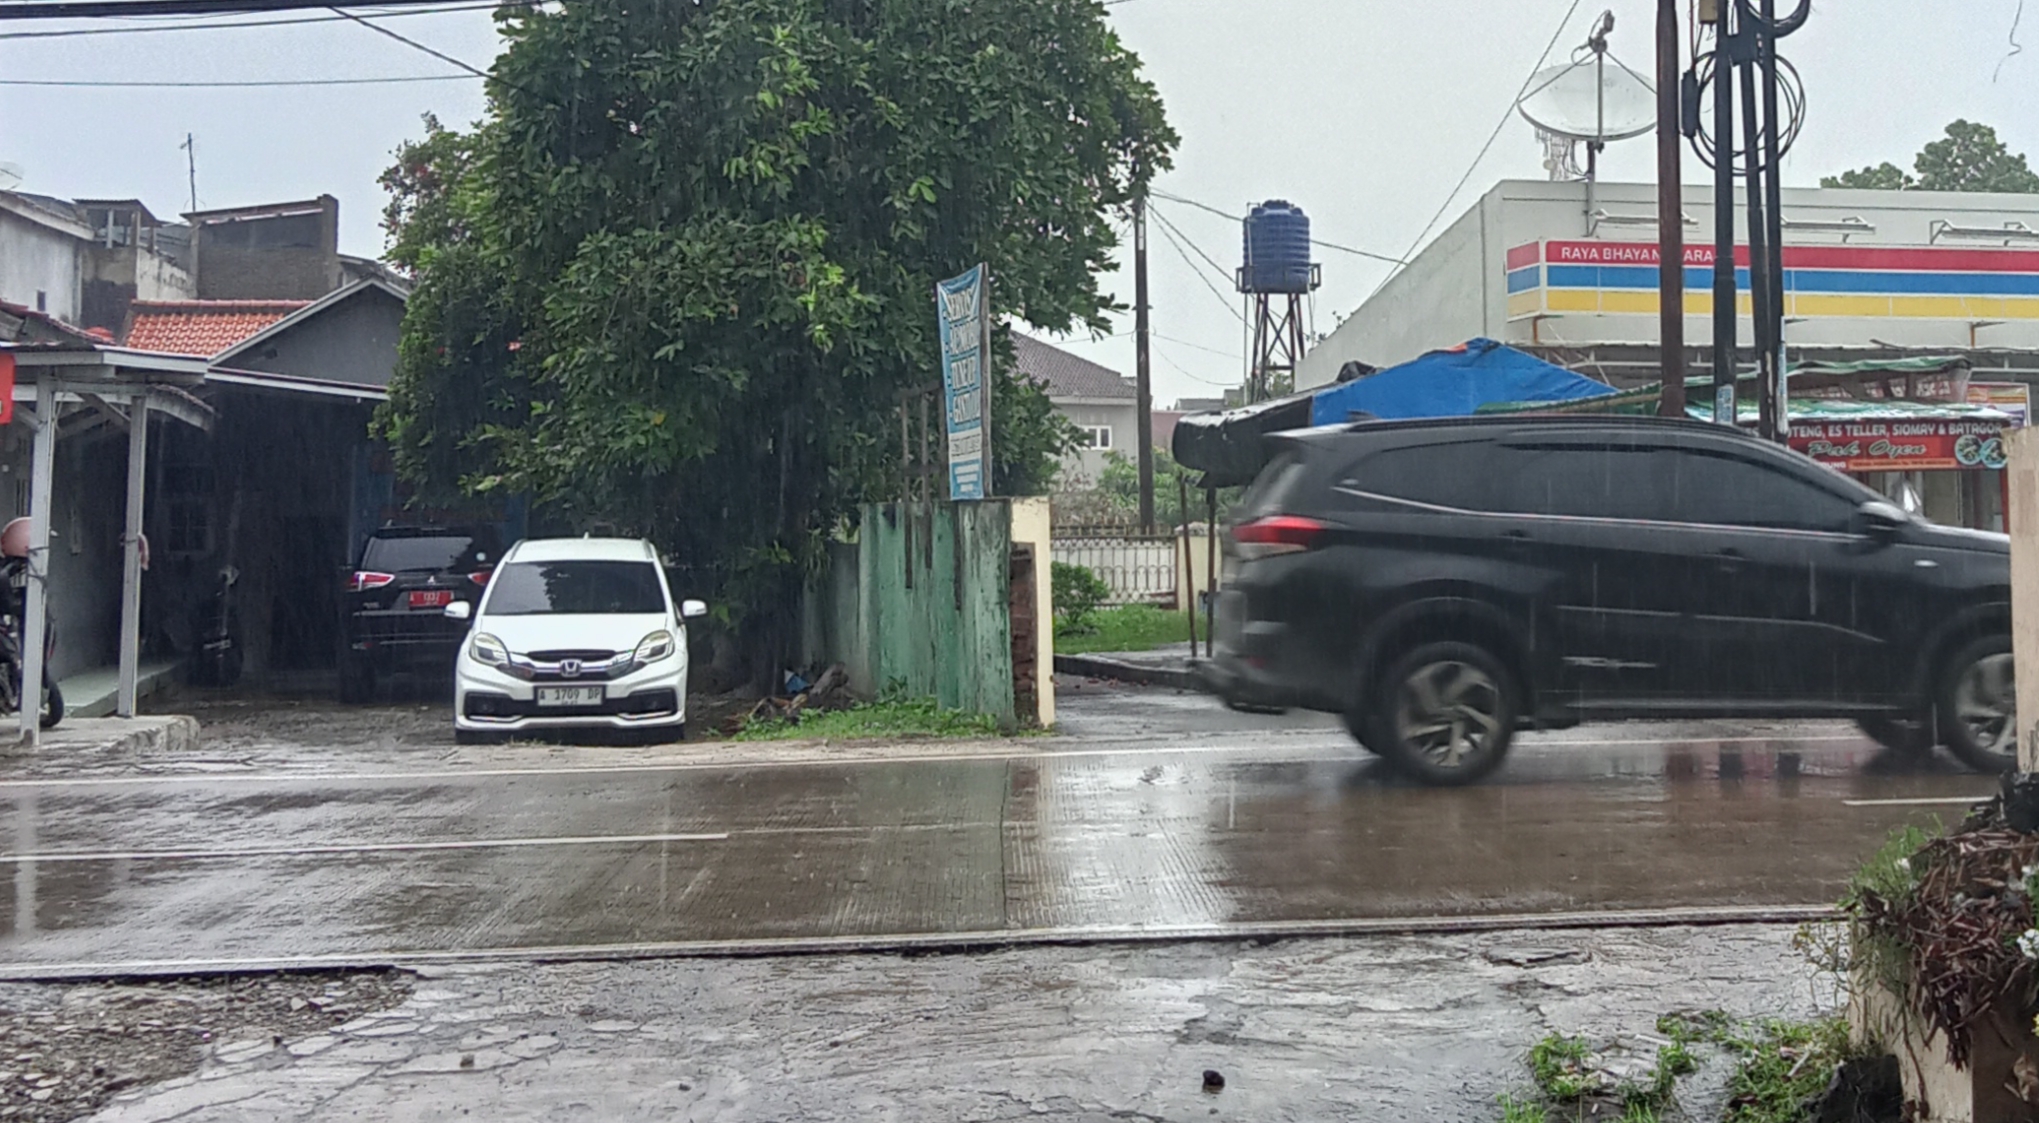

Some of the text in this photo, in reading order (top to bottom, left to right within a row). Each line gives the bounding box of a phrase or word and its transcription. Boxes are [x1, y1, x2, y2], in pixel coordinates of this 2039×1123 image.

[1561, 246, 1714, 262] RAYA BHAYANARA
[1828, 424, 1842, 437] ES
[1845, 424, 1890, 438] TELLER,
[1892, 423, 1936, 436] SIOMAY
[1938, 423, 1946, 435] &
[1807, 440, 1927, 458] Pak Oyen
[539, 689, 546, 700] A
[554, 688, 580, 700] 1709
